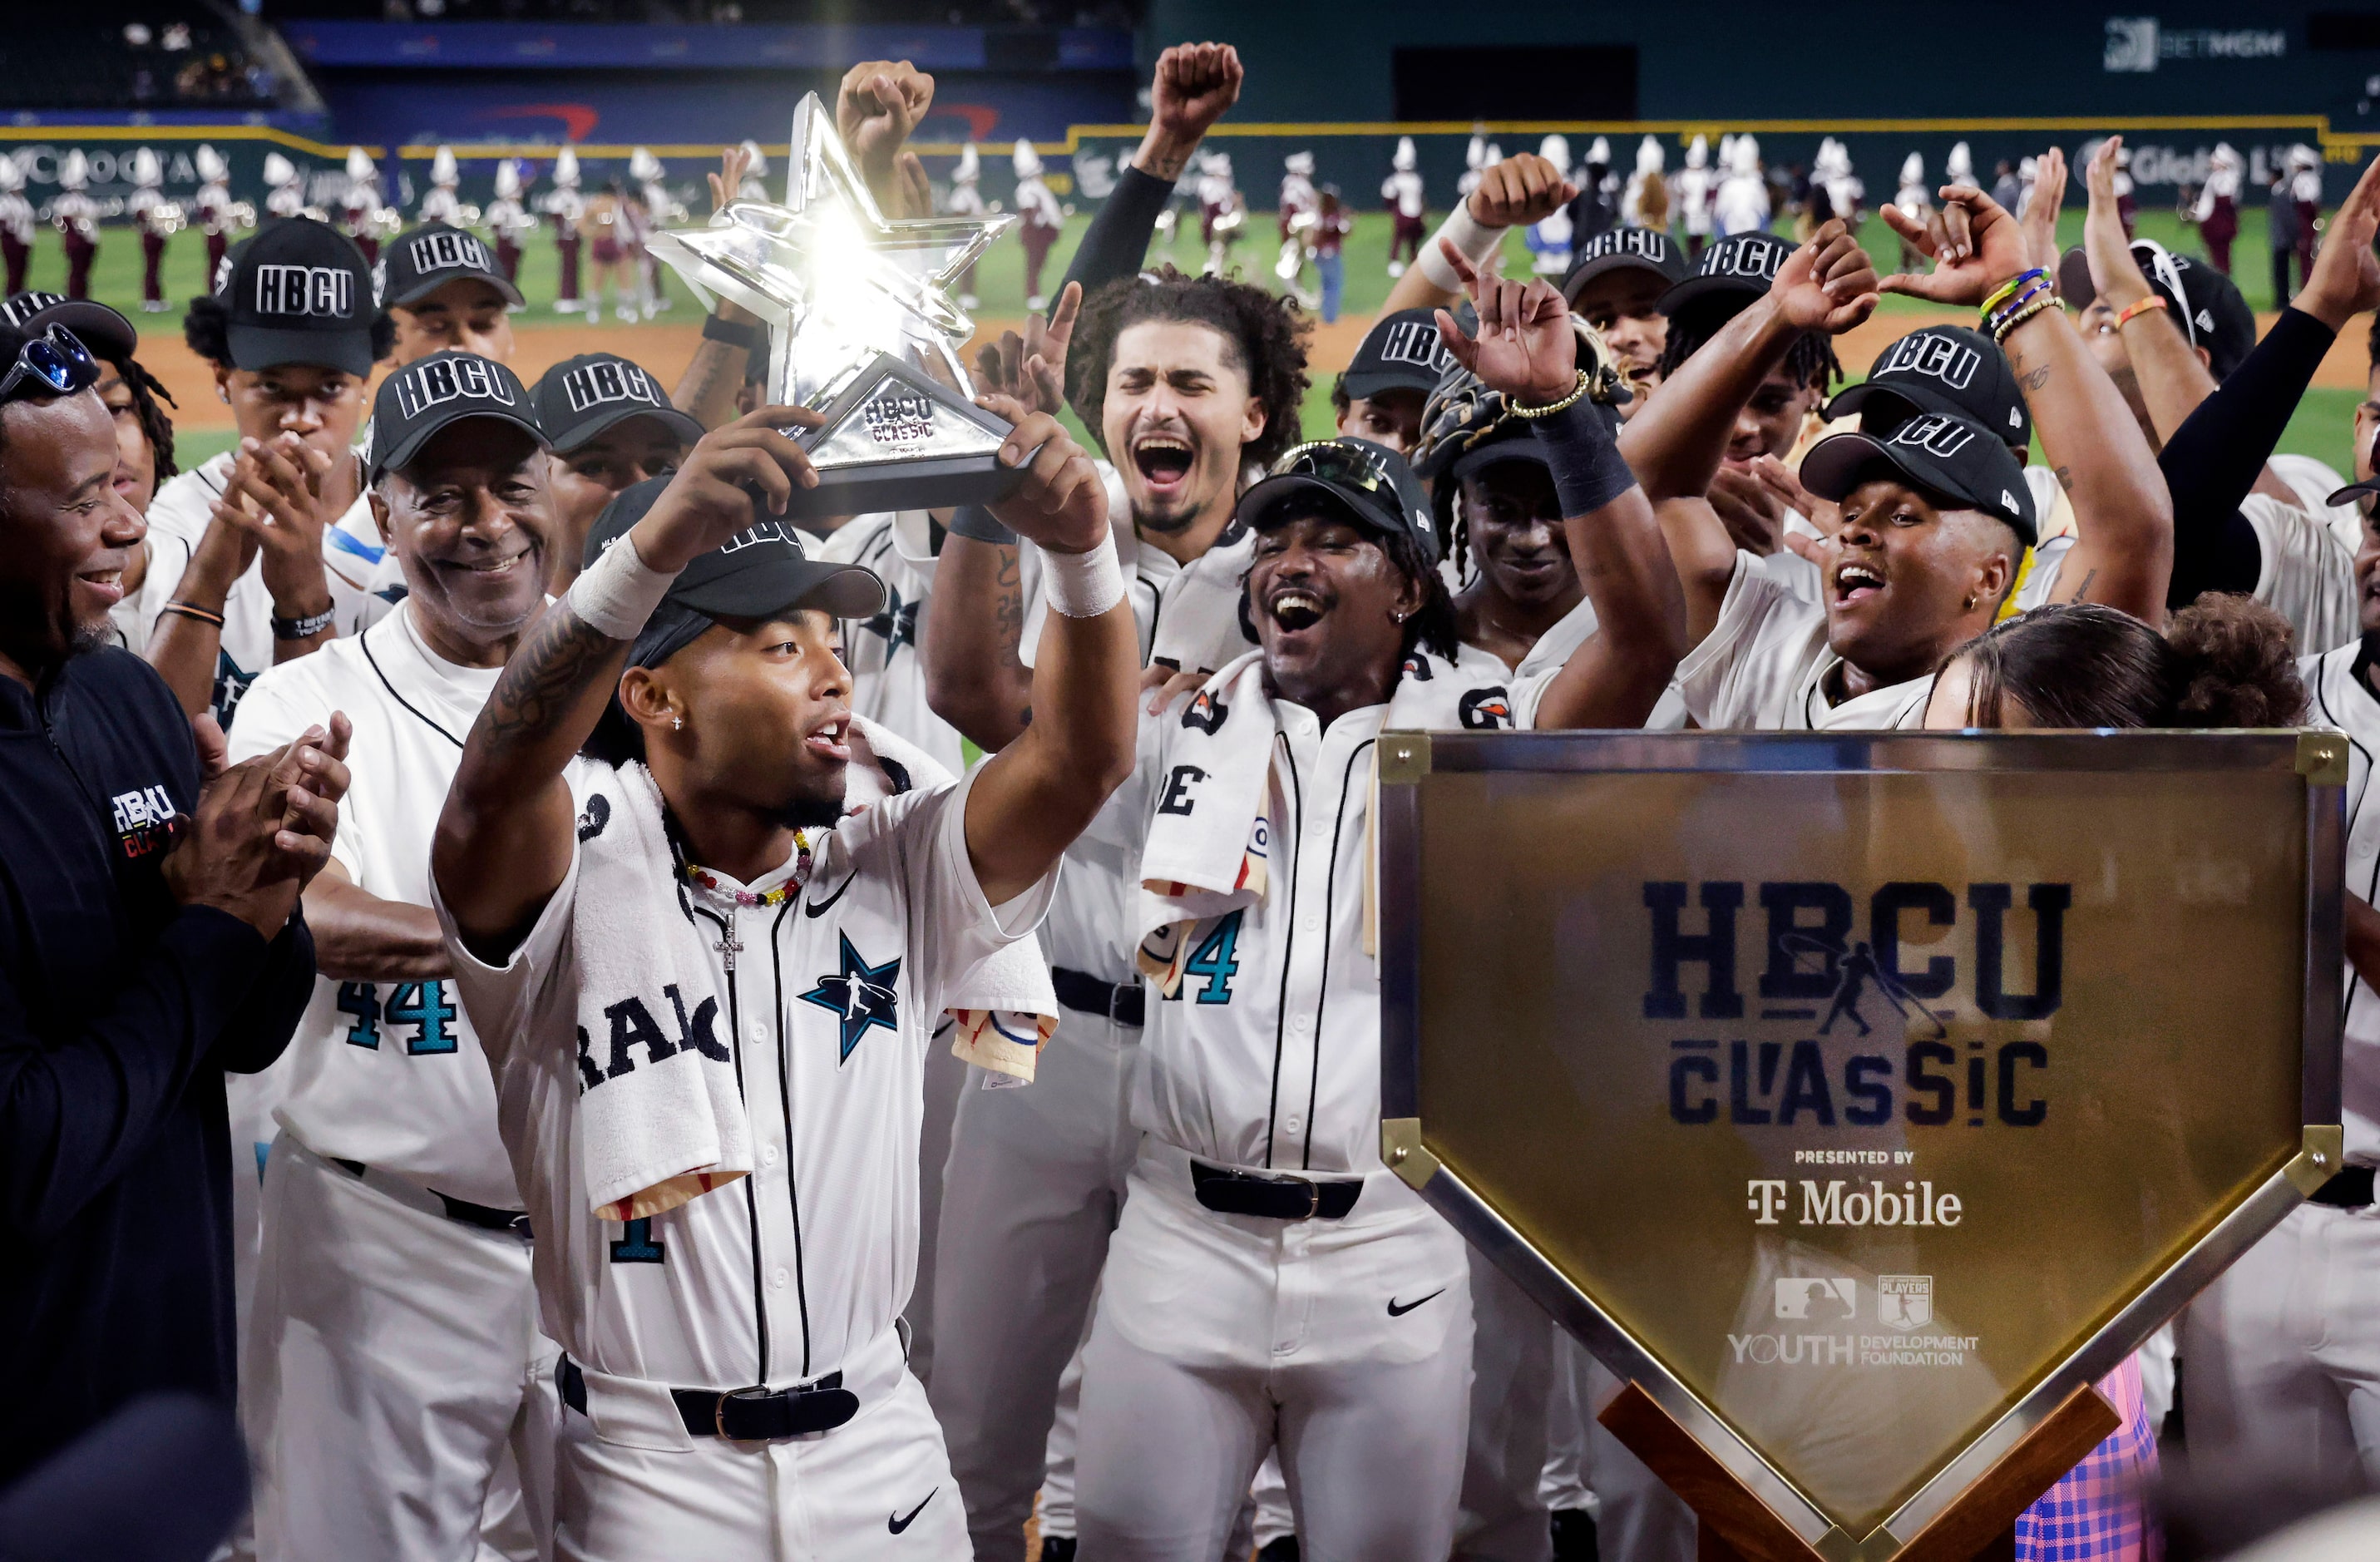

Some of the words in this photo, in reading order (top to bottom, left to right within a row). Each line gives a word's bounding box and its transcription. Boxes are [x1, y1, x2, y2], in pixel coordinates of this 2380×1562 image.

[409, 232, 492, 275] HBCU
[256, 264, 355, 319] HBCU
[395, 357, 516, 421] HBCU
[563, 361, 662, 413] HBCU
[865, 396, 935, 425] HBCU
[873, 421, 934, 442] CLASSIC
[1157, 764, 1212, 817] E
[1642, 881, 2072, 1021] HBCU
[337, 979, 458, 1055] 44
[1668, 1040, 2048, 1127] CLASSIC
[1795, 1150, 1889, 1165] PRESENTED
[1894, 1151, 1914, 1165] BY
[1748, 1179, 1786, 1225] T
[1799, 1179, 1963, 1227] Mobile
[1881, 1283, 1929, 1294] PLAYERS
[1726, 1334, 1854, 1366] YOUTH
[1860, 1336, 1979, 1351] DEVELOPMENT
[1860, 1352, 1963, 1366] FOUNDATION
